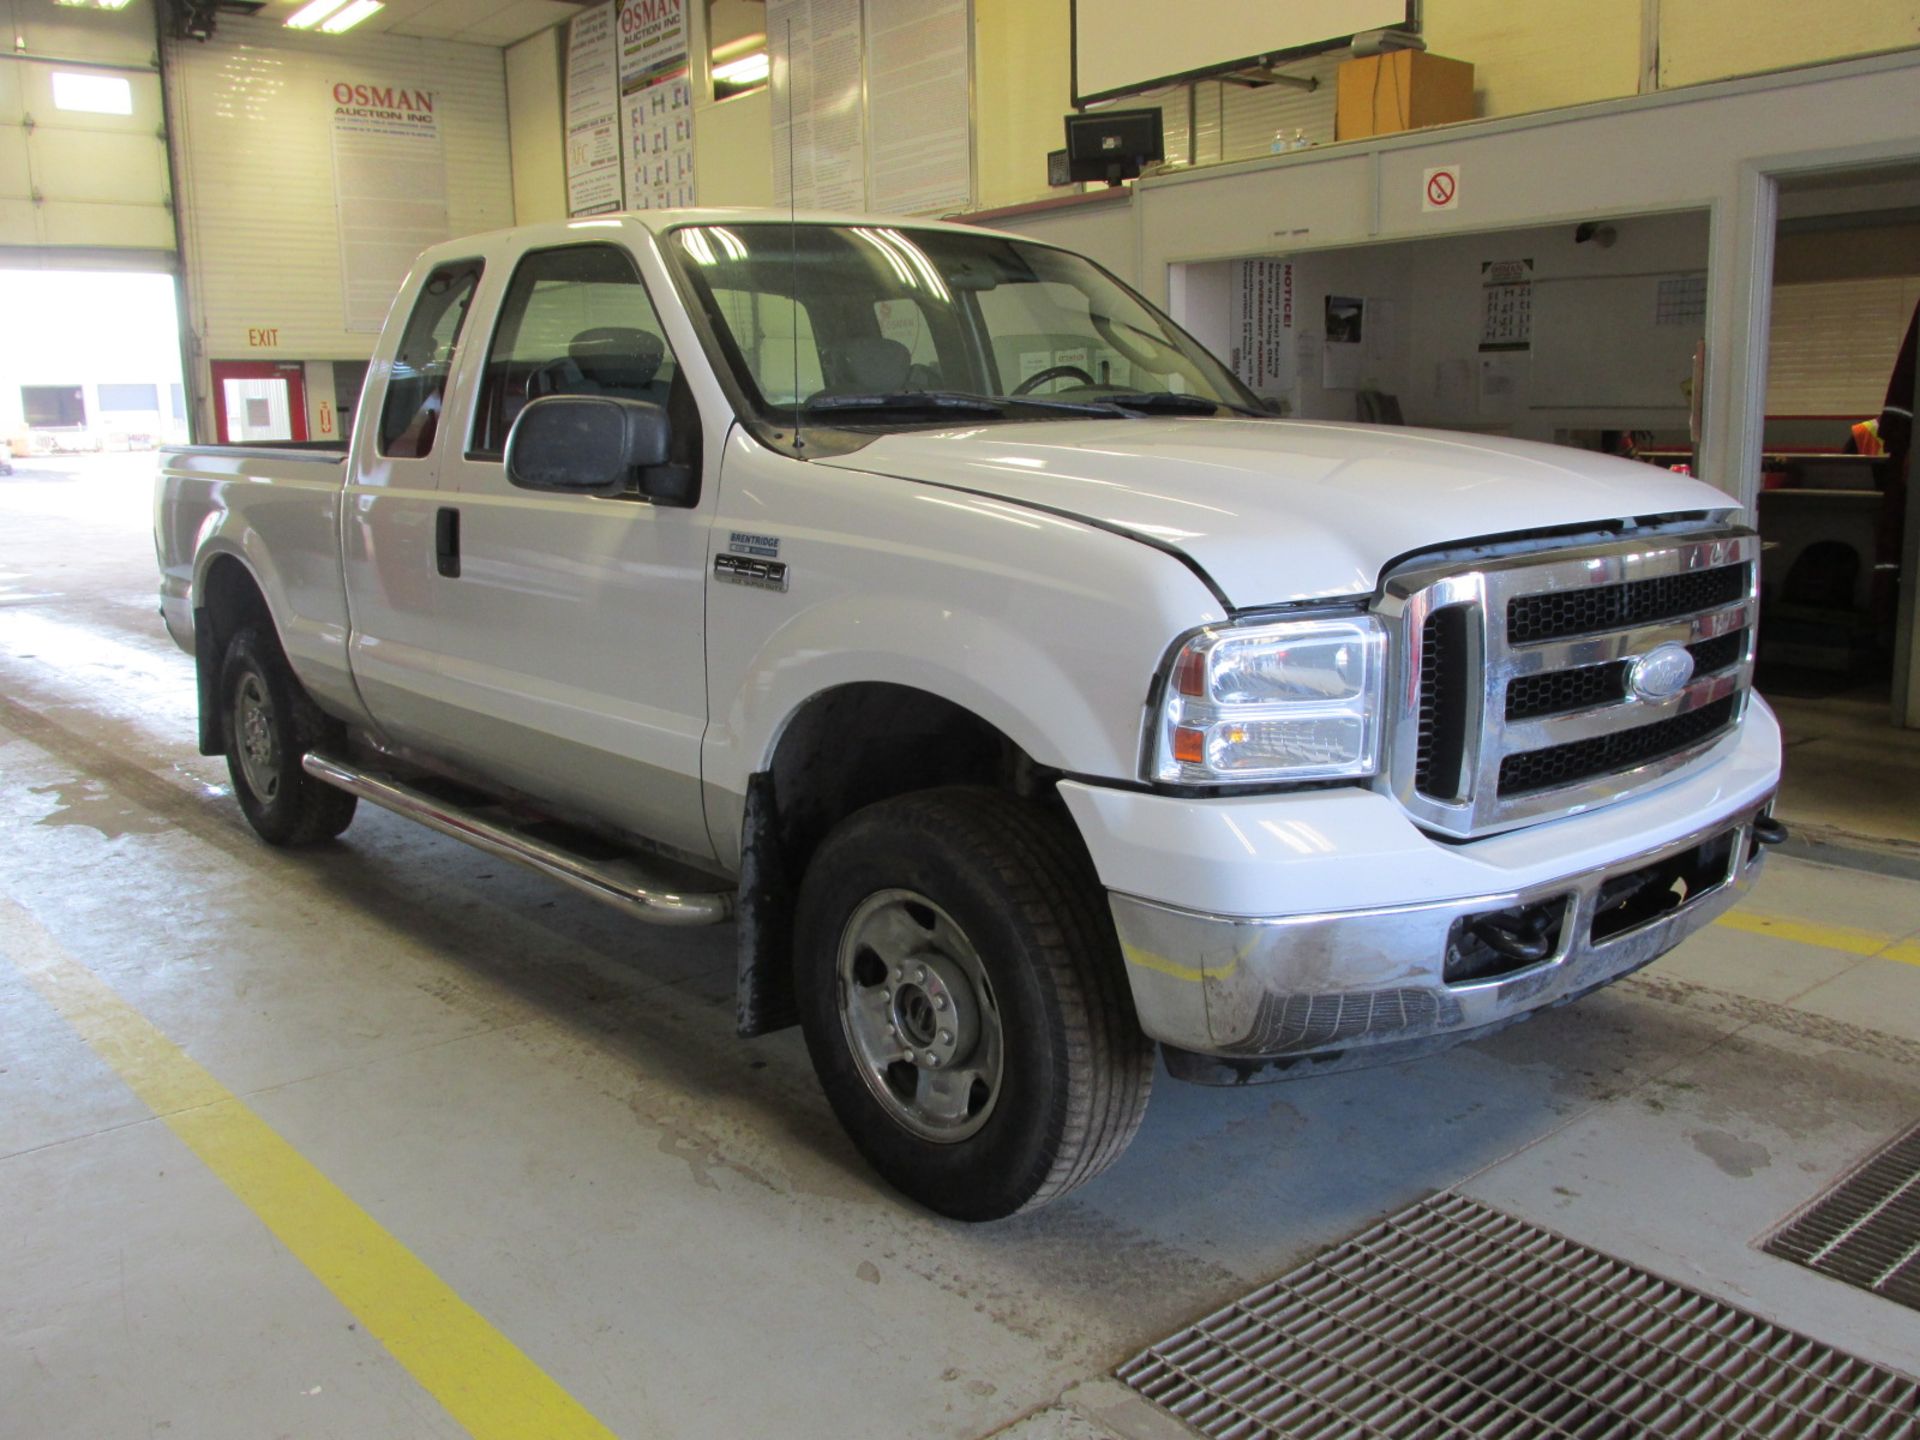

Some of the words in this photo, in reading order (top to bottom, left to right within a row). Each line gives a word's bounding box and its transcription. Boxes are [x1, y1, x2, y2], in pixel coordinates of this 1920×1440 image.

[621, 0, 681, 34] OSMAN
[624, 21, 662, 46] AUCTION
[664, 13, 681, 29] INC
[333, 82, 433, 113] OSMAN
[335, 107, 402, 120] AUCTION
[407, 113, 433, 123] INC
[1258, 261, 1264, 277] NO
[1283, 264, 1293, 328] NOTICE!
[249, 329, 278, 346] EXIT
[730, 532, 780, 548] BRENTRIDGE
